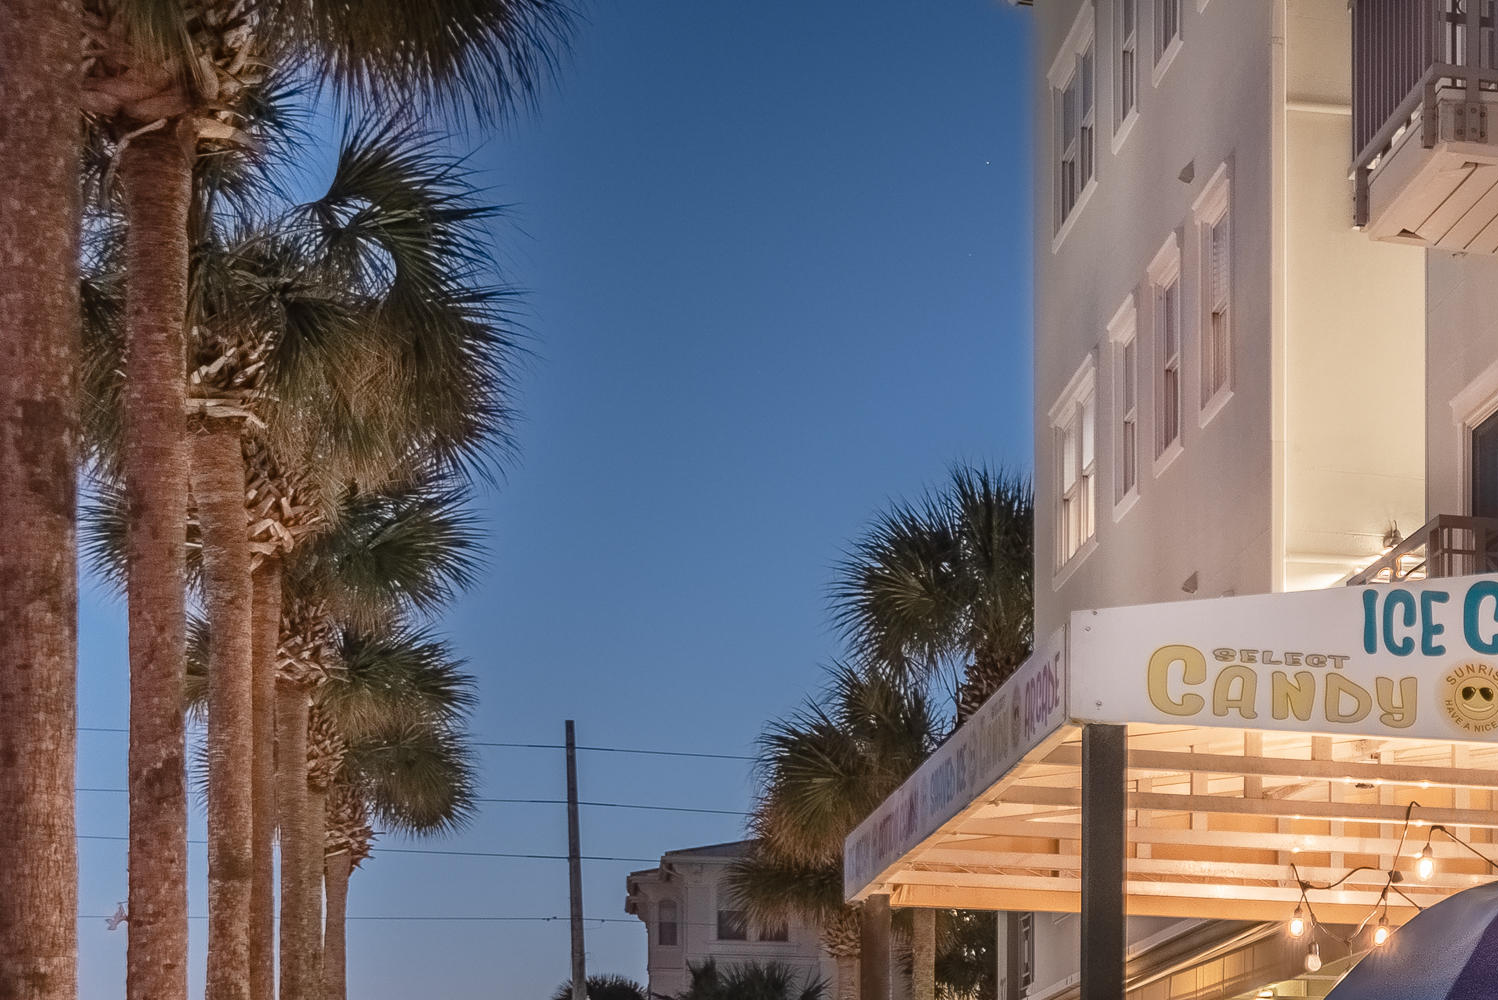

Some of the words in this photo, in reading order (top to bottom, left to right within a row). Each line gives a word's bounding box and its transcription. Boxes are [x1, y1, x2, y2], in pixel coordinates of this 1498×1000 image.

[1362, 588, 1450, 657] ICE
[1147, 644, 1418, 729] CANDY
[1212, 647, 1351, 669] SELECT
[1024, 651, 1060, 741] ARCADE
[1445, 700, 1463, 725] HAVE
[1463, 723, 1470, 731] A
[1474, 721, 1498, 733] NICE
